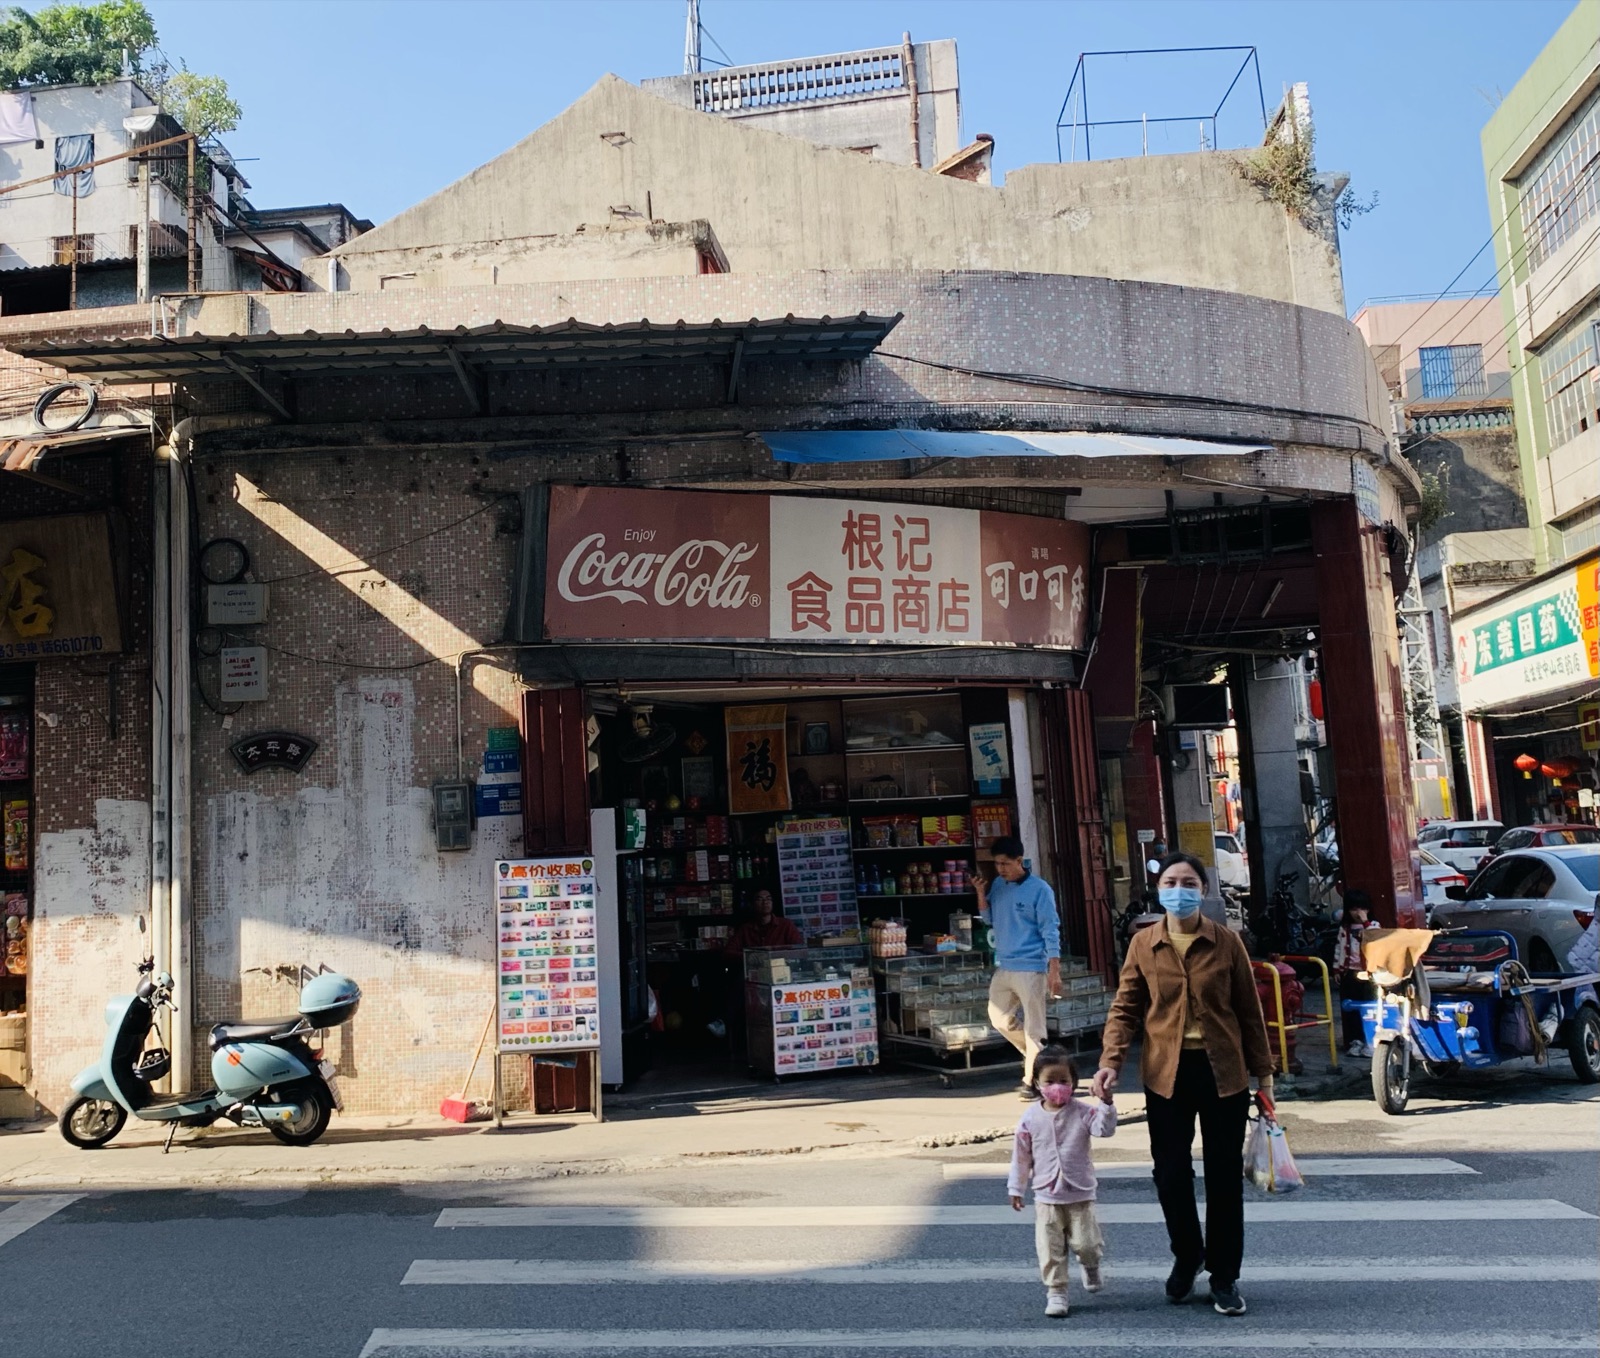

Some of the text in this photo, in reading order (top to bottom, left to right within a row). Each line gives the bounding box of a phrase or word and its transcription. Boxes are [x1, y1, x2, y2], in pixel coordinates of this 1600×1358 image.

[624, 528, 657, 543] Enjoy
[841, 510, 932, 574] 根记
[0, 547, 53, 637] 店
[557, 532, 760, 609] Coca-Cola
[985, 560, 1086, 612] 可口可乐
[786, 571, 970, 634] 食品商店
[1476, 602, 1559, 667] 东莞国药
[246, 741, 302, 759] 太平路
[500, 760, 504, 770] 1
[739, 738, 777, 792] 福
[786, 819, 841, 833] 高价收购
[511, 863, 581, 879] 高价收购
[784, 987, 842, 1004] 高价收购
